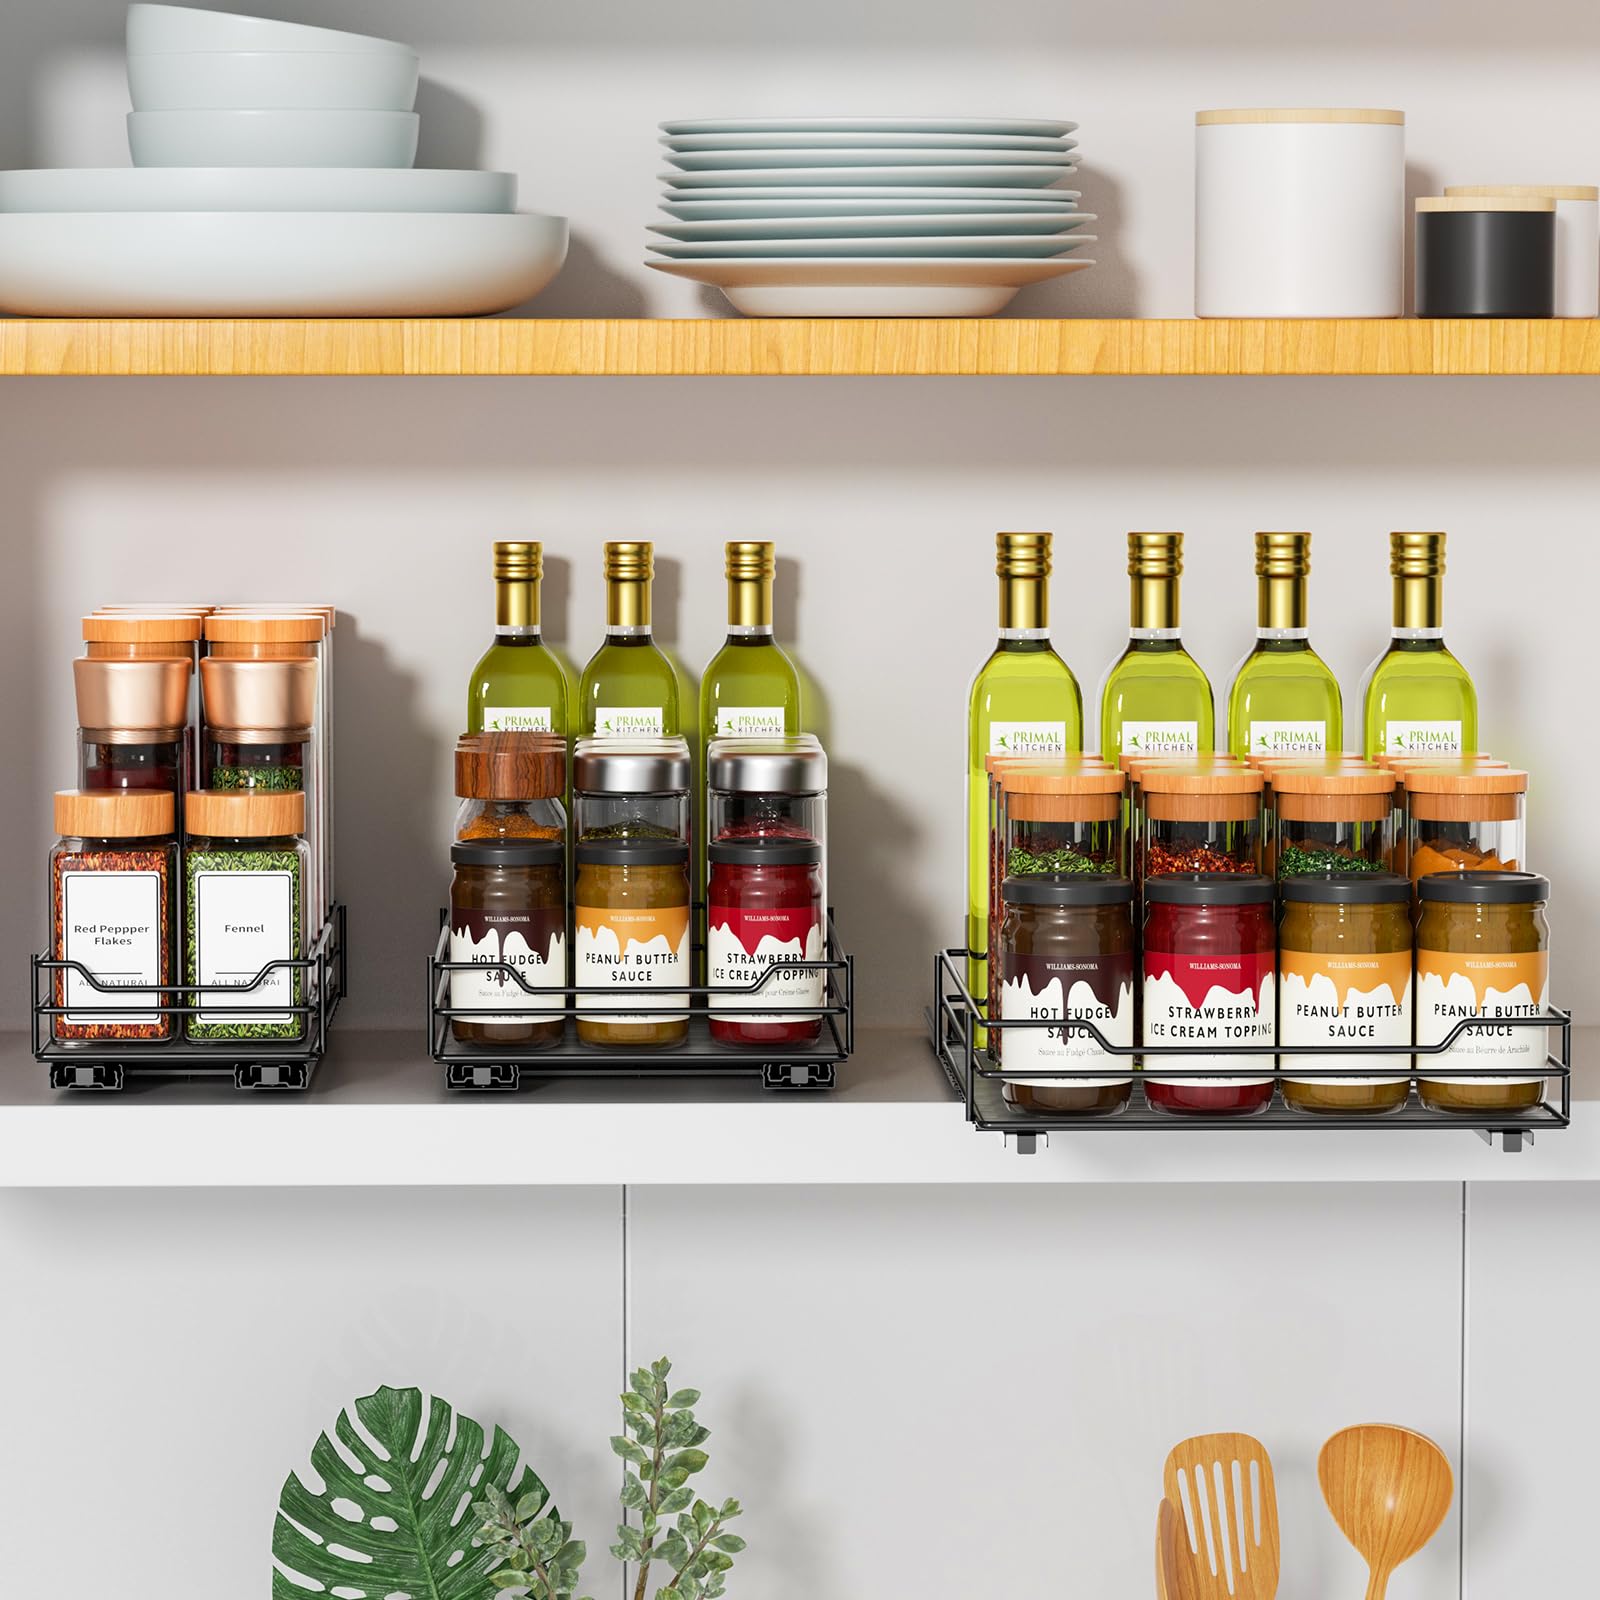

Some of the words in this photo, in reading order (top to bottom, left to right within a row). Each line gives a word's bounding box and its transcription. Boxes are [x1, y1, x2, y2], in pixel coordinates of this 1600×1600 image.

[505, 716, 546, 726] PRIMAL
[617, 716, 656, 726] PRIMAL
[739, 716, 780, 726] PRIMAL
[1013, 731, 1061, 743] PRIMAL
[1146, 731, 1192, 743] PRIMAL
[1274, 731, 1320, 743] PRIMAL
[1409, 731, 1456, 743] PRIMAL
[74, 924, 97, 933] Red
[100, 924, 150, 936] Peppper
[225, 924, 265, 933] Fennel
[94, 936, 132, 946] Flakes
[471, 954, 496, 964] HOT
[586, 953, 630, 965] PEANUT
[636, 953, 679, 965] BUTTER
[727, 953, 804, 965] STRAWBERRY
[1189, 962, 1242, 970] WILLIAMS-SONOMA
[486, 971, 527, 982] SAUE
[611, 971, 652, 981] SAUCE
[713, 968, 725, 979] ICE
[775, 968, 819, 981] TOPPING
[1030, 1007, 1059, 1019] HOT
[1168, 1006, 1257, 1019] STRAWBERRY
[1296, 1004, 1350, 1018] PEANUT
[1357, 1004, 1403, 1018] BUTTER
[1434, 1003, 1488, 1017] PEANUT
[1495, 1003, 1541, 1017] BUTTER
[1150, 1022, 1165, 1036] ICE
[1170, 1025, 1217, 1038] CREAM
[1225, 1022, 1272, 1038] TOPPING
[1328, 1025, 1375, 1037] SAUCE
[1466, 1026, 1513, 1037] SAUCE
